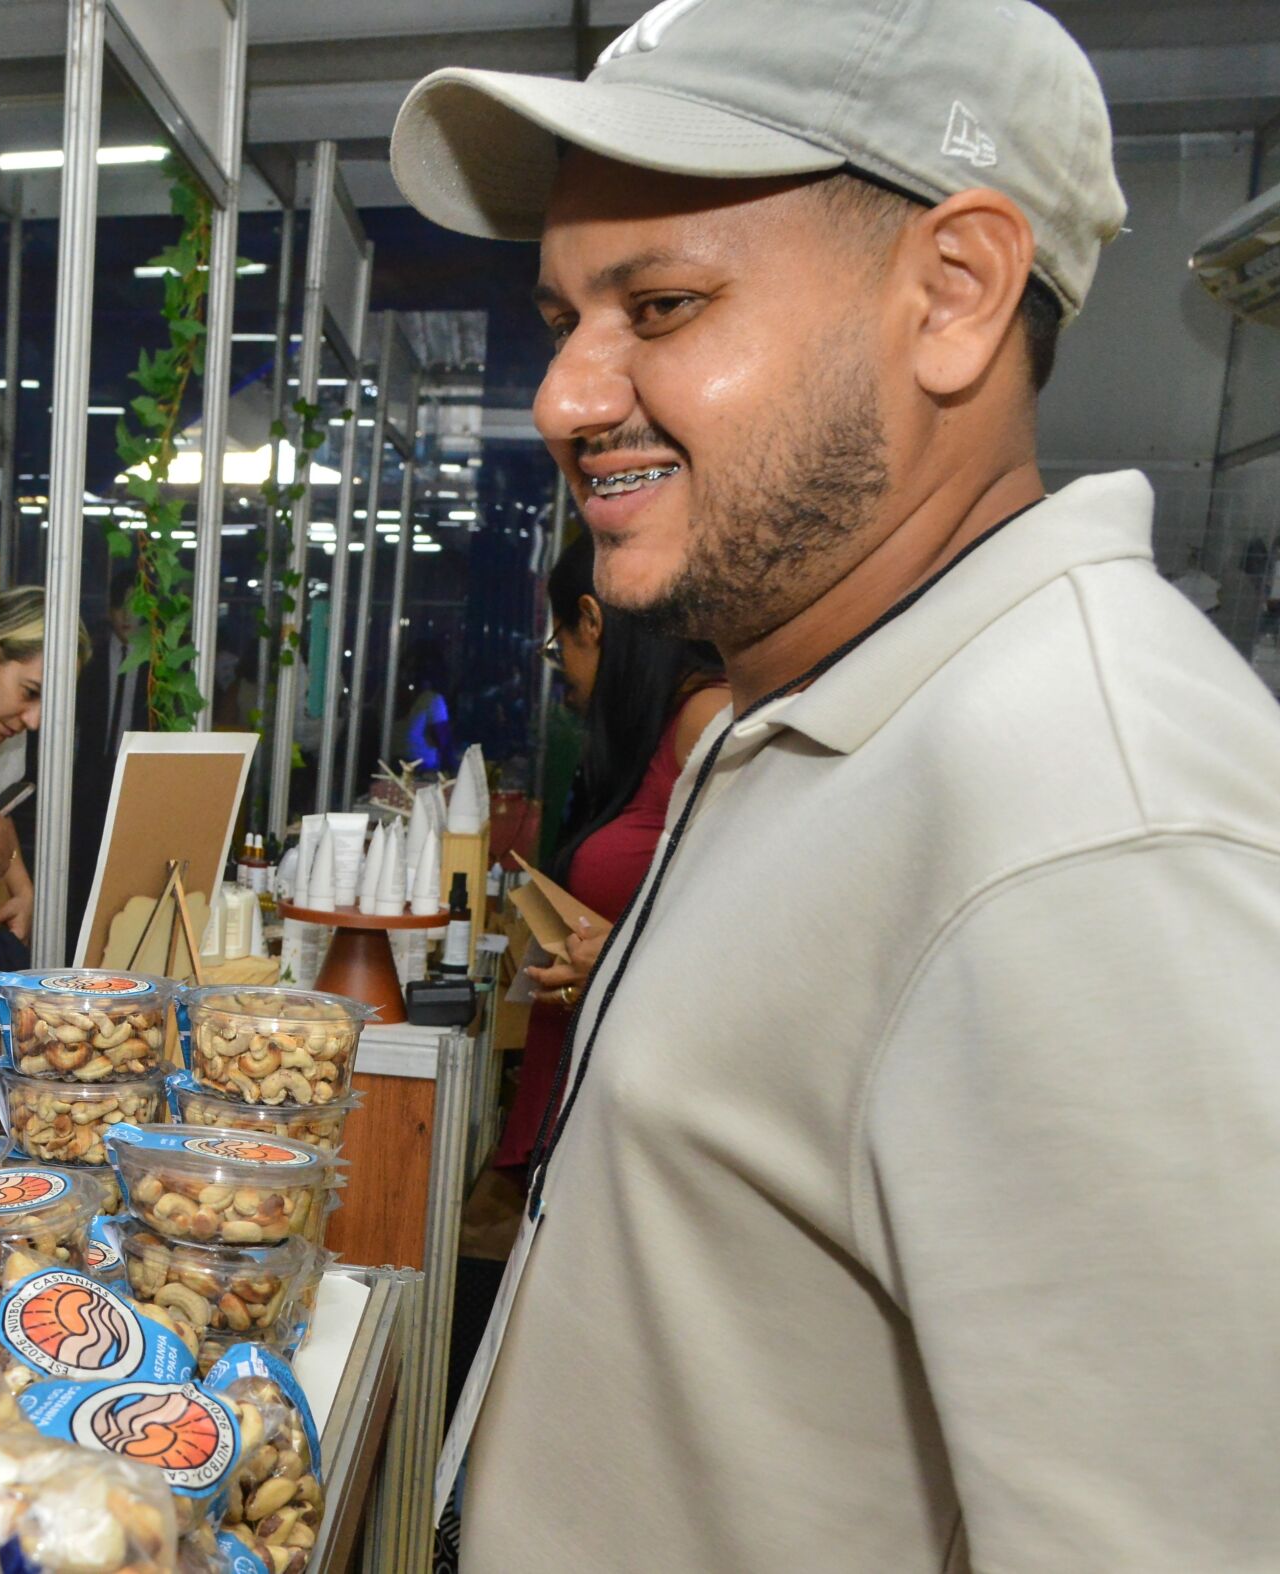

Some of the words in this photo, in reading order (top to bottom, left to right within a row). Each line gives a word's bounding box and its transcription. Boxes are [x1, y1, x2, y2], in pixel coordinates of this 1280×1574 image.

[9, 1294, 28, 1334] NUTBOX
[32, 1274, 111, 1299] CASTANHAS
[152, 1334, 168, 1380] ASTANHA
